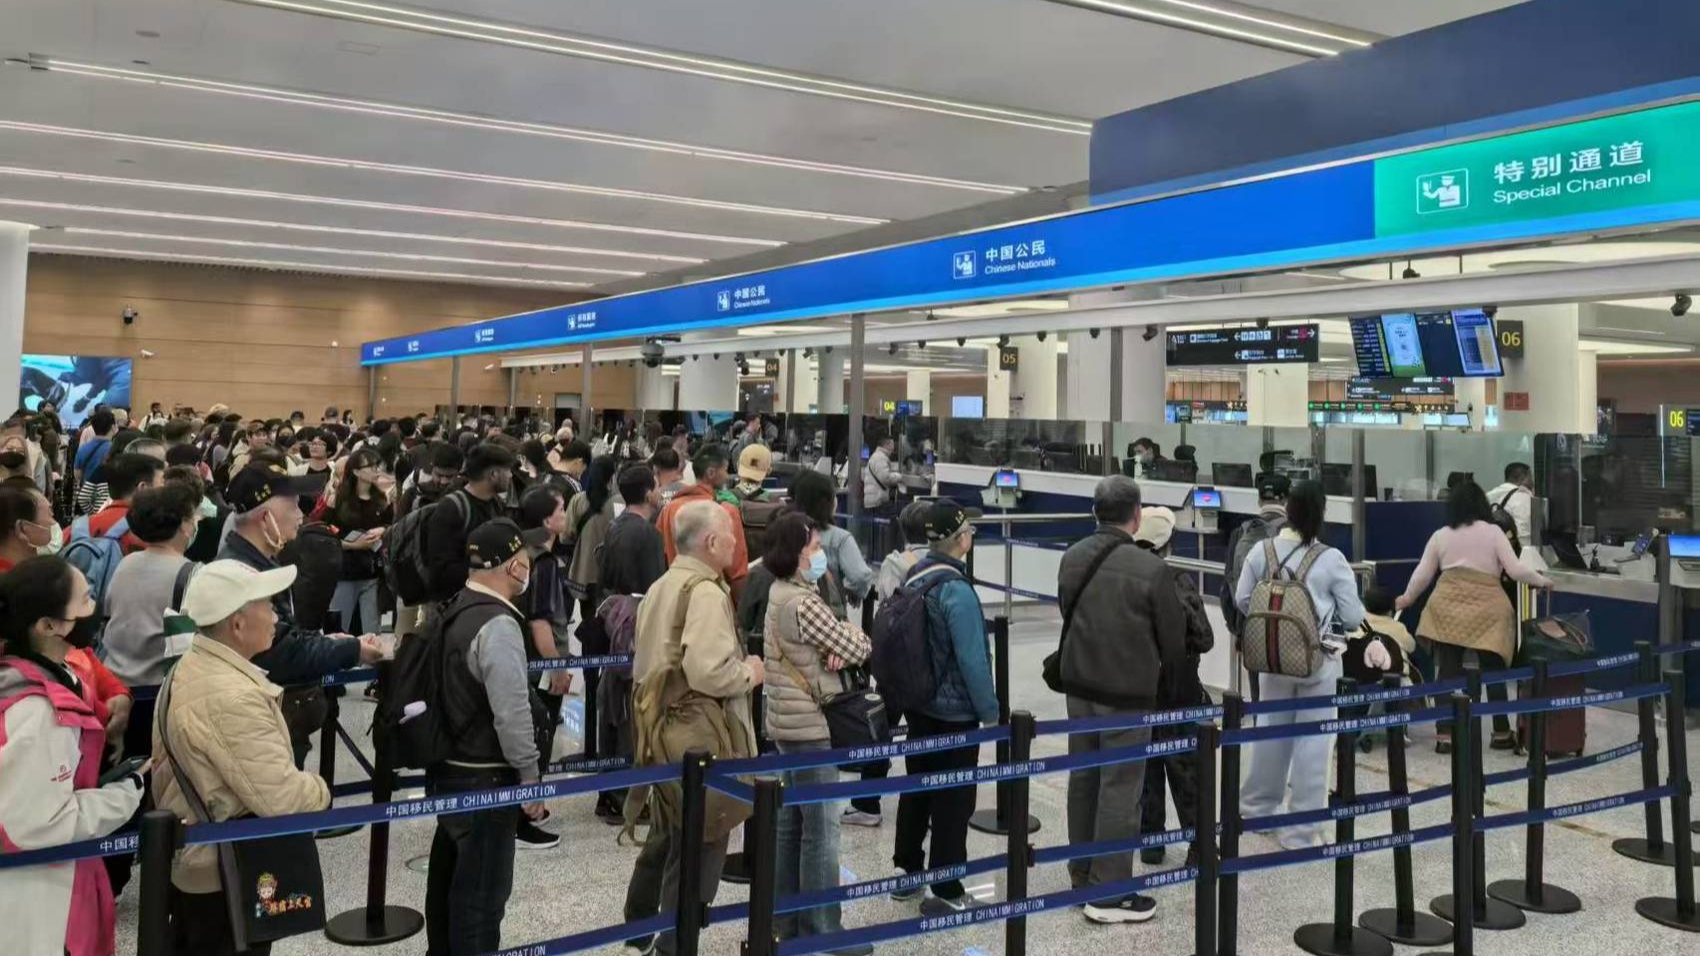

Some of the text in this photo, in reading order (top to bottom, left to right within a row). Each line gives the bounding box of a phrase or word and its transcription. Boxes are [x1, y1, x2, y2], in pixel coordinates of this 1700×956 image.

[1494, 140, 1644, 184] 特别通道
[1493, 169, 1651, 204] Special Channel
[985, 239, 1046, 262] 中国公民
[984, 256, 1056, 275] Chinese Nationals
[1501, 331, 1521, 346] 06
[767, 363, 777, 371] 04
[1002, 353, 1016, 364] 05
[1670, 410, 1684, 427] 06
[848, 744, 898, 760] 中国移民管理
[1146, 738, 1189, 755] 中国移民管理
[921, 760, 1046, 787] 中国移民管理 CHINAIMMIGRATION
[386, 784, 556, 818] 中国移民管理 CHINAIMMIGRATION
[1145, 868, 1188, 887] 中国移民管理
[846, 879, 897, 899] 中国移民管理
[920, 898, 1046, 932] 中国移民管理 CHINAIMMIGRATION
